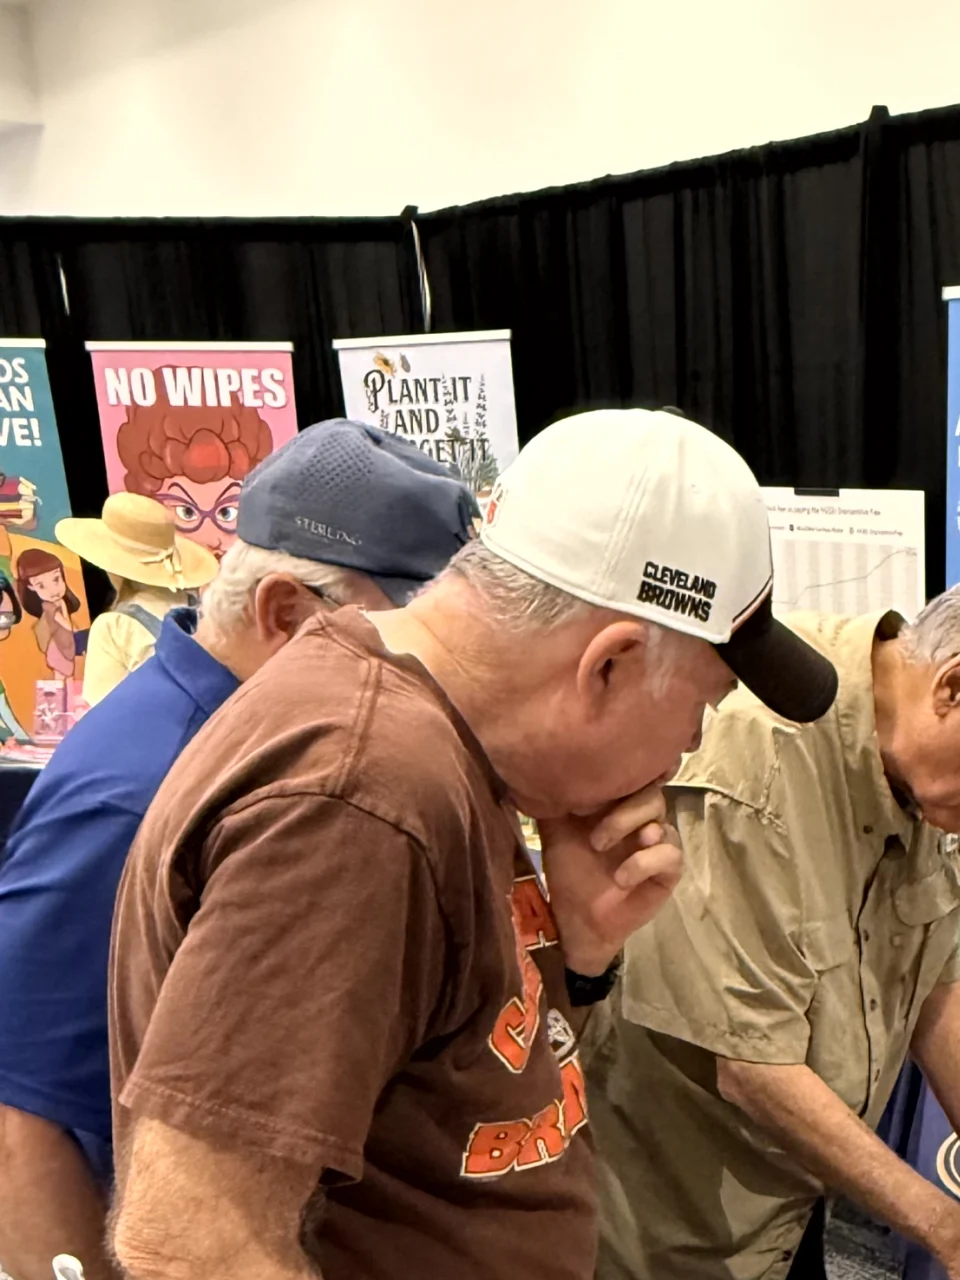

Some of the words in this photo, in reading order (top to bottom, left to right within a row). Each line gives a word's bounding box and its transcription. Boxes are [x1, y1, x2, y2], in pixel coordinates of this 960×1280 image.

[104, 367, 157, 407] NO
[161, 366, 287, 409] WIPES
[363, 369, 441, 413] PLANT
[451, 376, 471, 402] IT
[395, 408, 439, 434] AND
[637, 580, 712, 622] BROWNS
[643, 561, 717, 600] CLEVELAND
